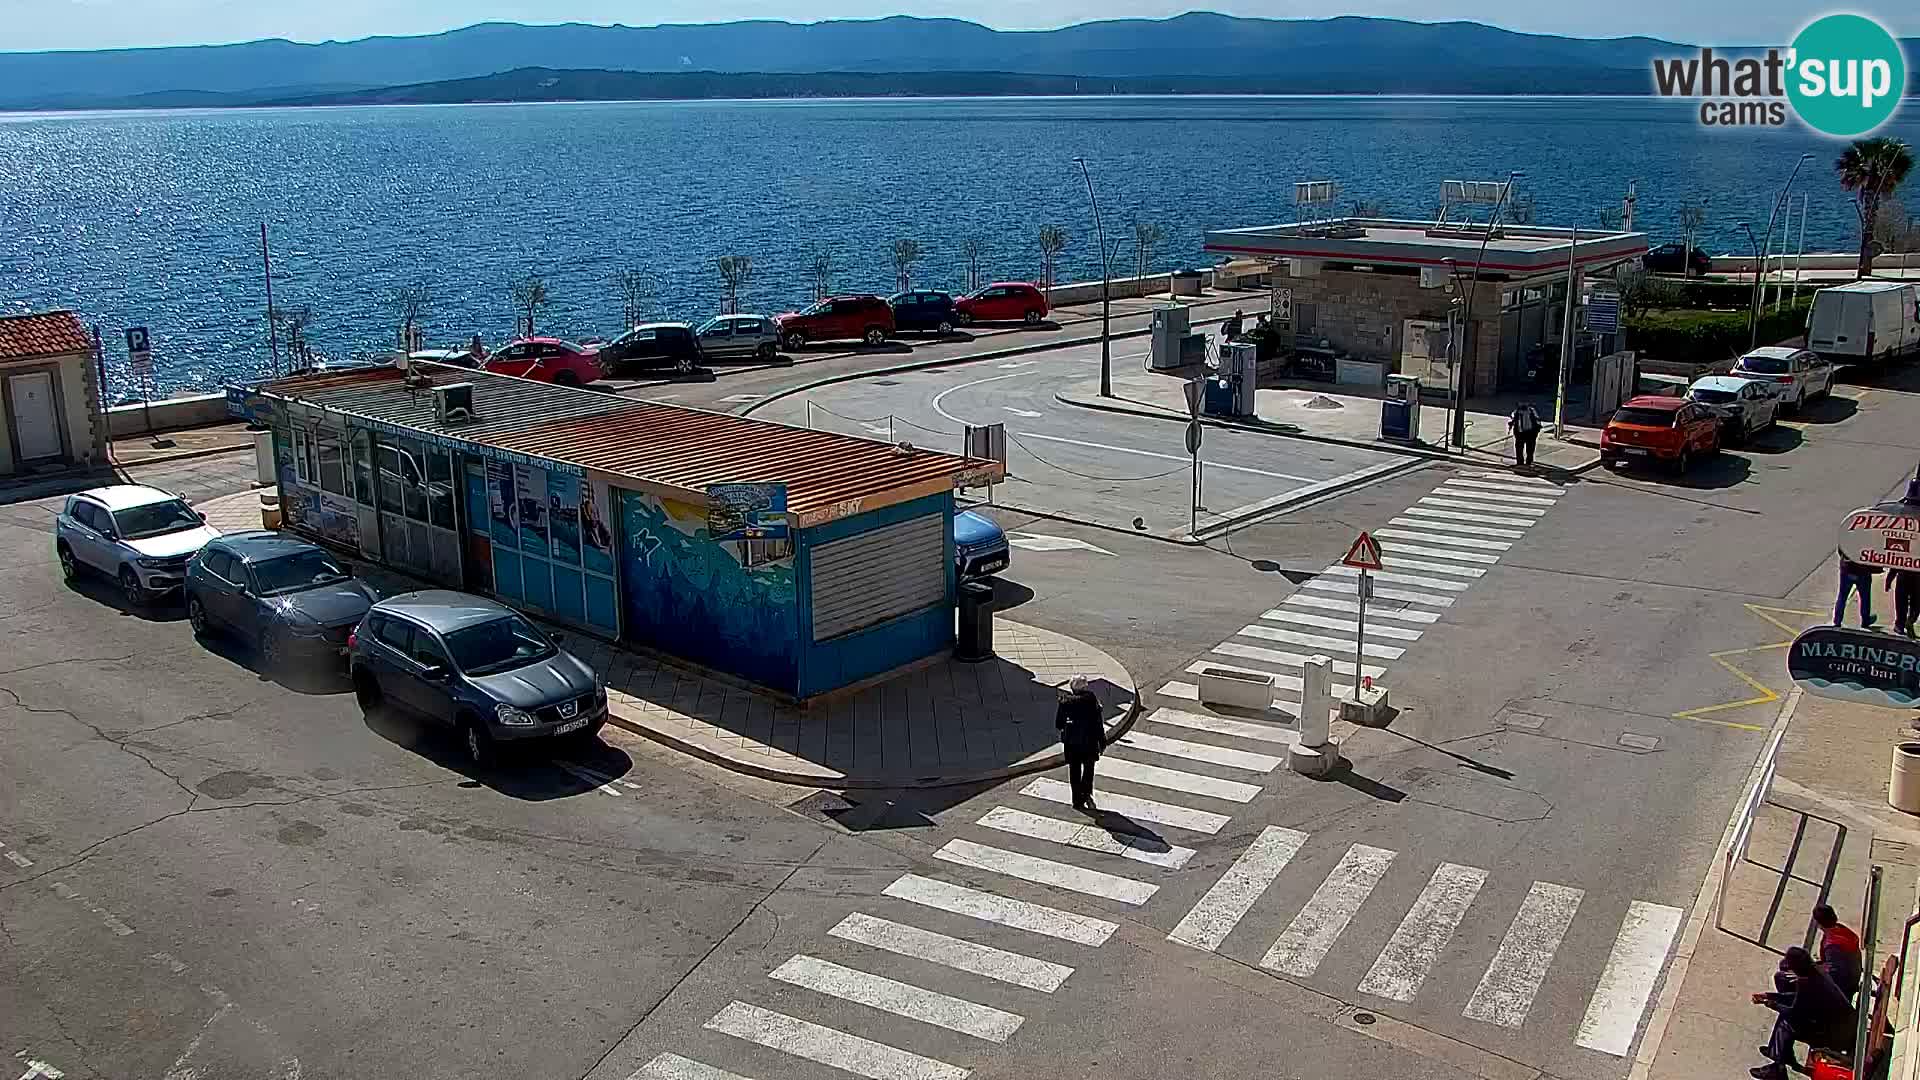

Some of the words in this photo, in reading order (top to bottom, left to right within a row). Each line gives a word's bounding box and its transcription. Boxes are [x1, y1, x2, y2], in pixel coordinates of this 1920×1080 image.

[131, 331, 144, 349] P
[479, 446, 494, 457] BUS
[495, 450, 527, 464] STATION
[529, 457, 555, 471] TICKET
[556, 463, 584, 477] OFFICE
[1848, 515, 1920, 533] PIZZE
[1801, 642, 1920, 673] MARINER
[1828, 662, 1866, 673] caffe
[1870, 665, 1897, 680] bar
